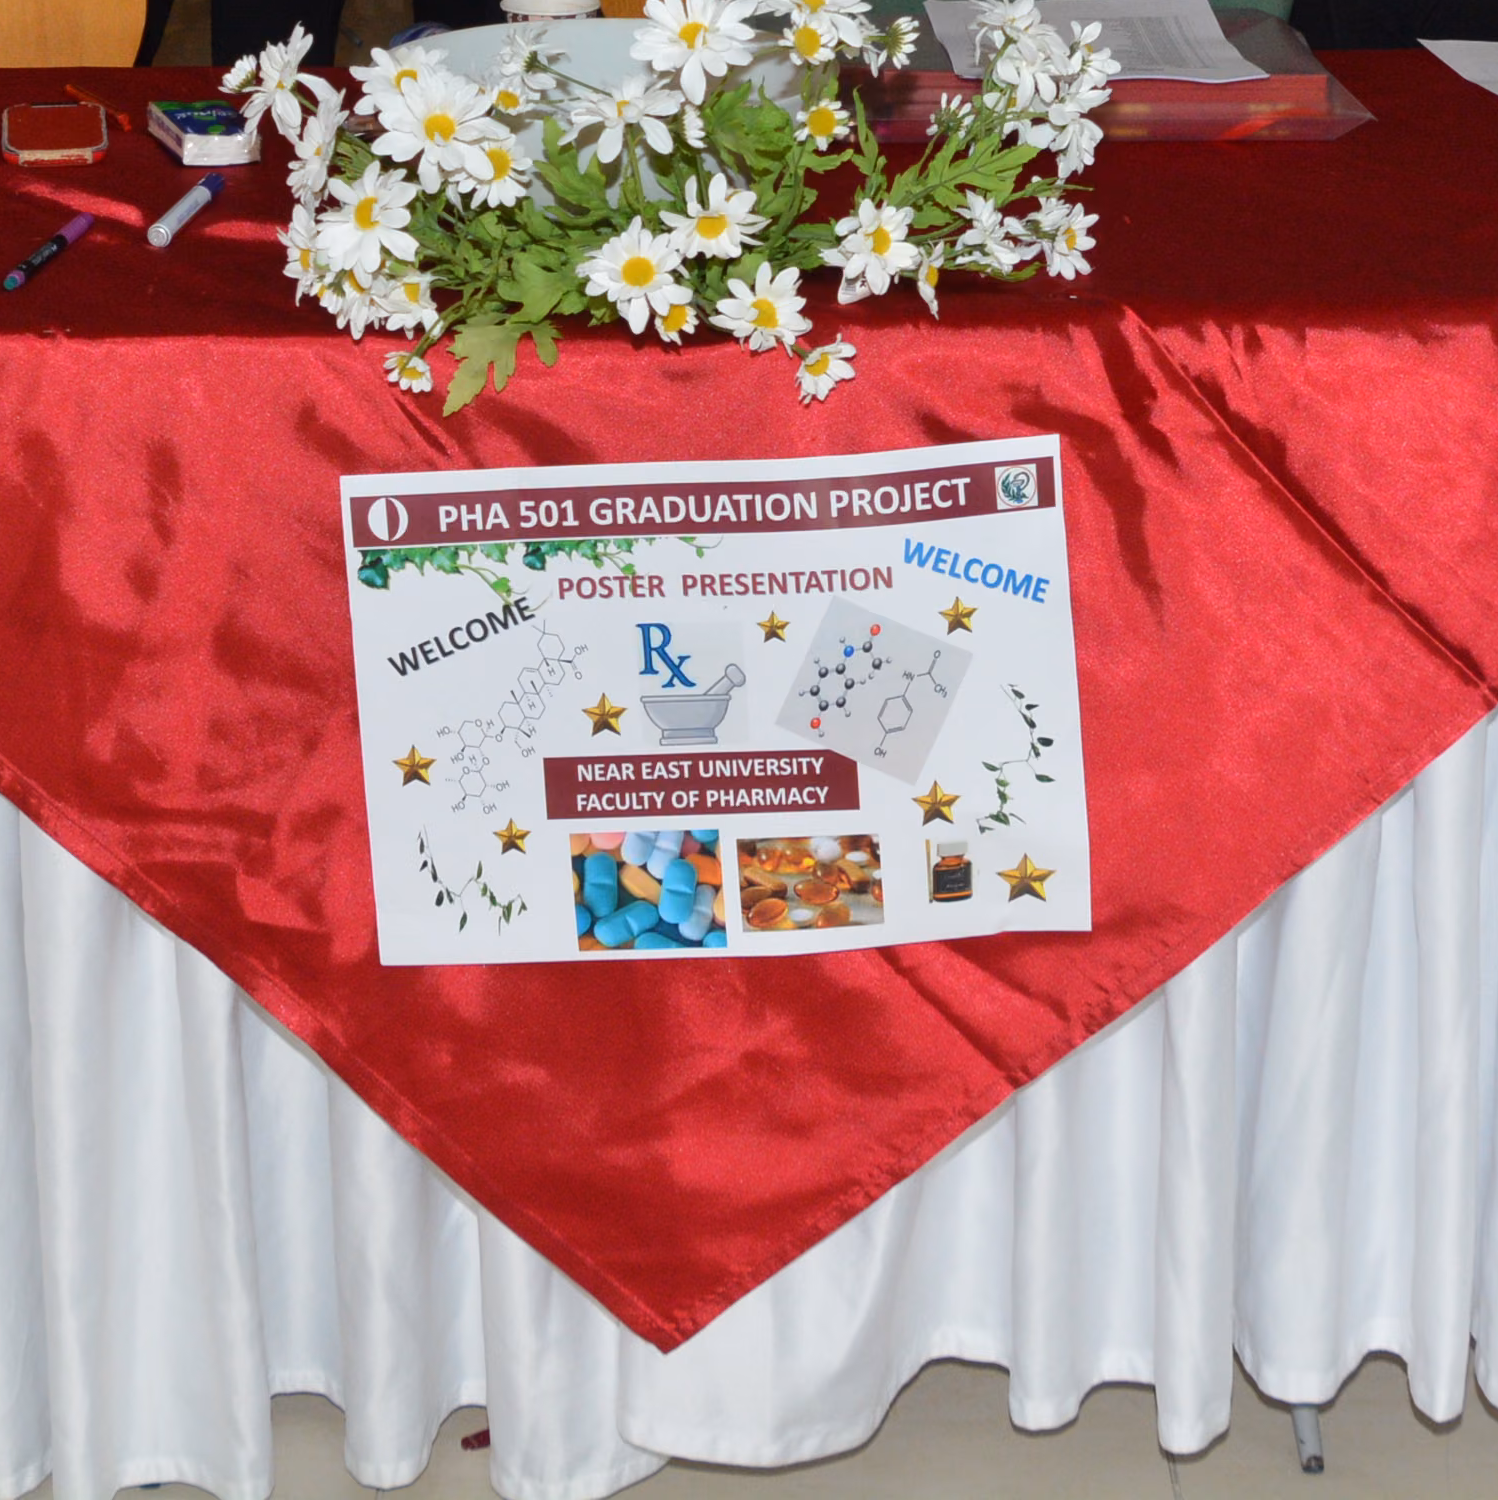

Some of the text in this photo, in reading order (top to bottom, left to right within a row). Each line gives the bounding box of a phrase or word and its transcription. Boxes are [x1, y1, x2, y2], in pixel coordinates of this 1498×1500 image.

[437, 476, 972, 534] PHA 501 GRADUATION PROJECT
[557, 566, 894, 601] POSTER PRESENTATION
[902, 538, 1051, 604] WELCOME
[387, 596, 536, 678] WELCOME
[577, 757, 824, 782] NEAR EAST UNIVERSITY
[576, 786, 829, 812] FACULTY OF PHARMACY
